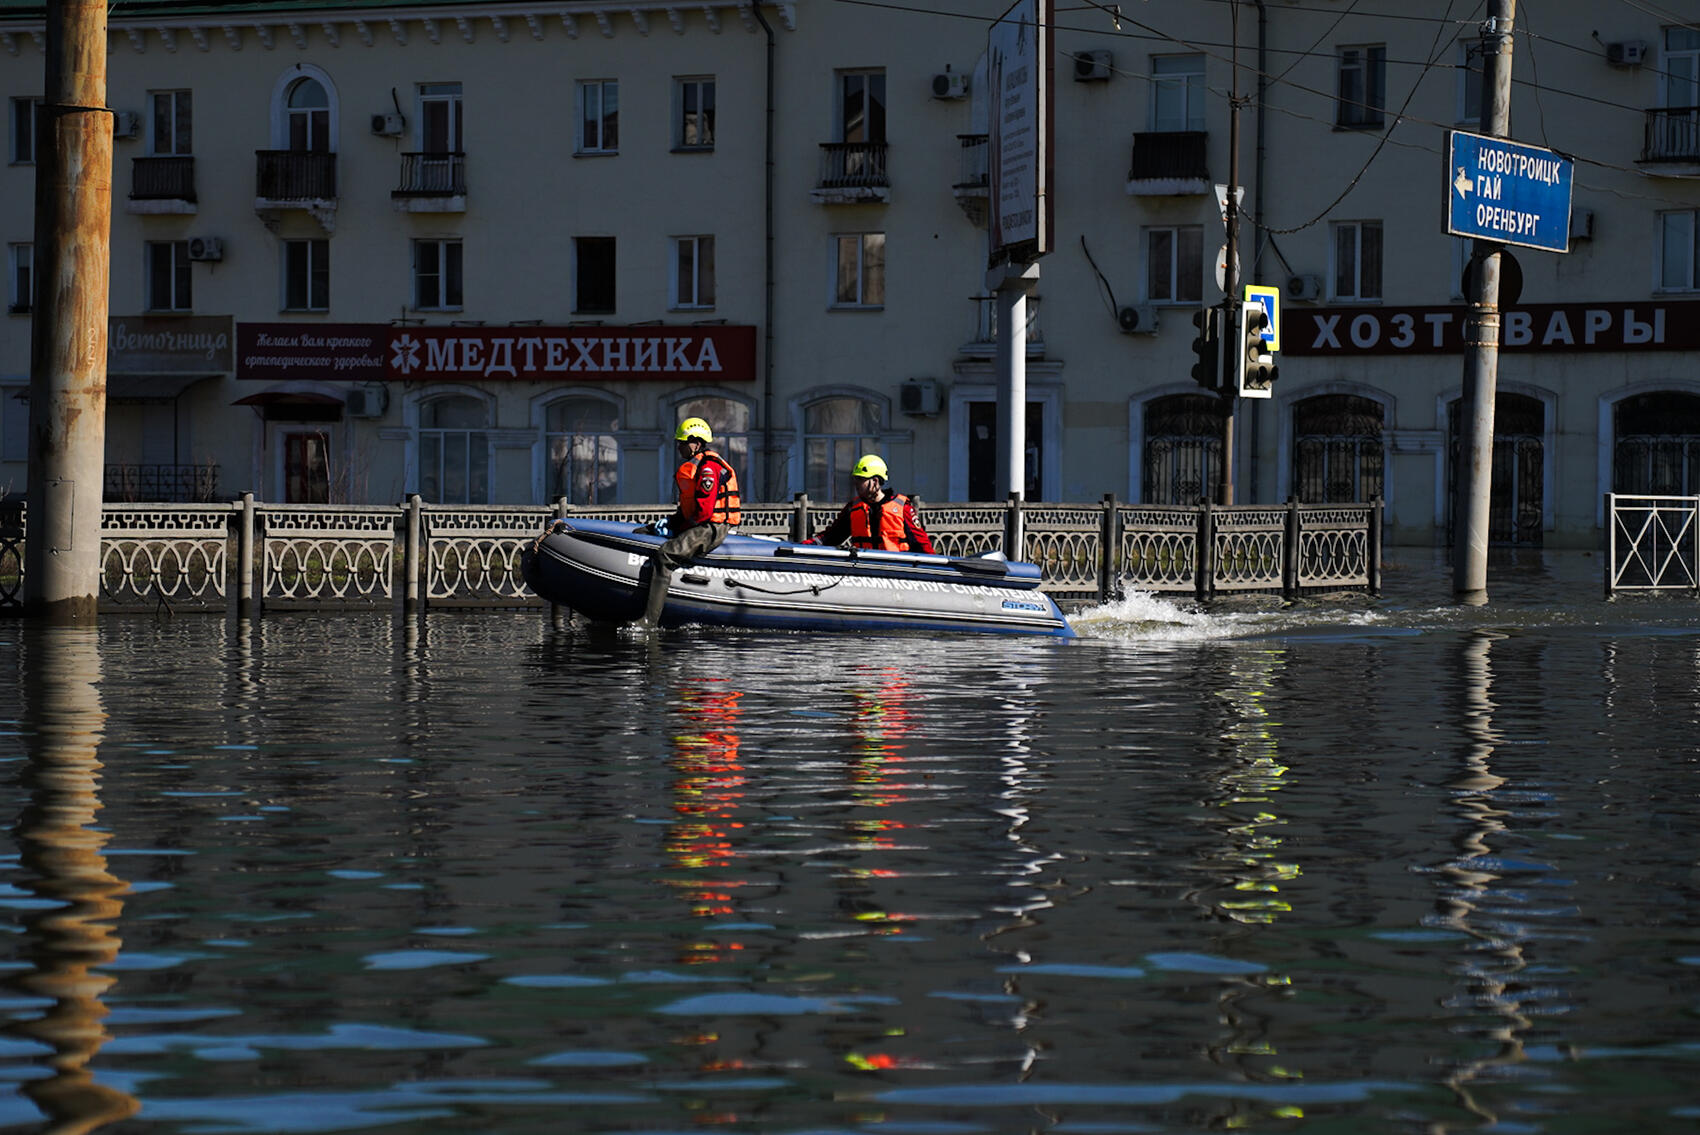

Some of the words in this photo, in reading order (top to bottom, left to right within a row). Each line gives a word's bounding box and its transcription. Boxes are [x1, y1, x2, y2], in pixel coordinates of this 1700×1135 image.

[1478, 147, 1561, 186] НОВОТРОИЦК
[1477, 174, 1502, 200] ГАЙ
[1476, 204, 1540, 236] ОРЕНБУРГ
[256, 333, 299, 347] Желаем
[300, 333, 325, 347] Вам
[327, 336, 372, 350] крепкого
[1311, 309, 1666, 349] ХОЗТВАРЫ
[245, 355, 331, 369] ортопедического
[333, 353, 384, 370] здоровья!
[425, 337, 723, 377] МЕДТЕХНИКА
[628, 552, 770, 581] ВСССИЙСКИЙ
[890, 578, 950, 593] КОРПУС
